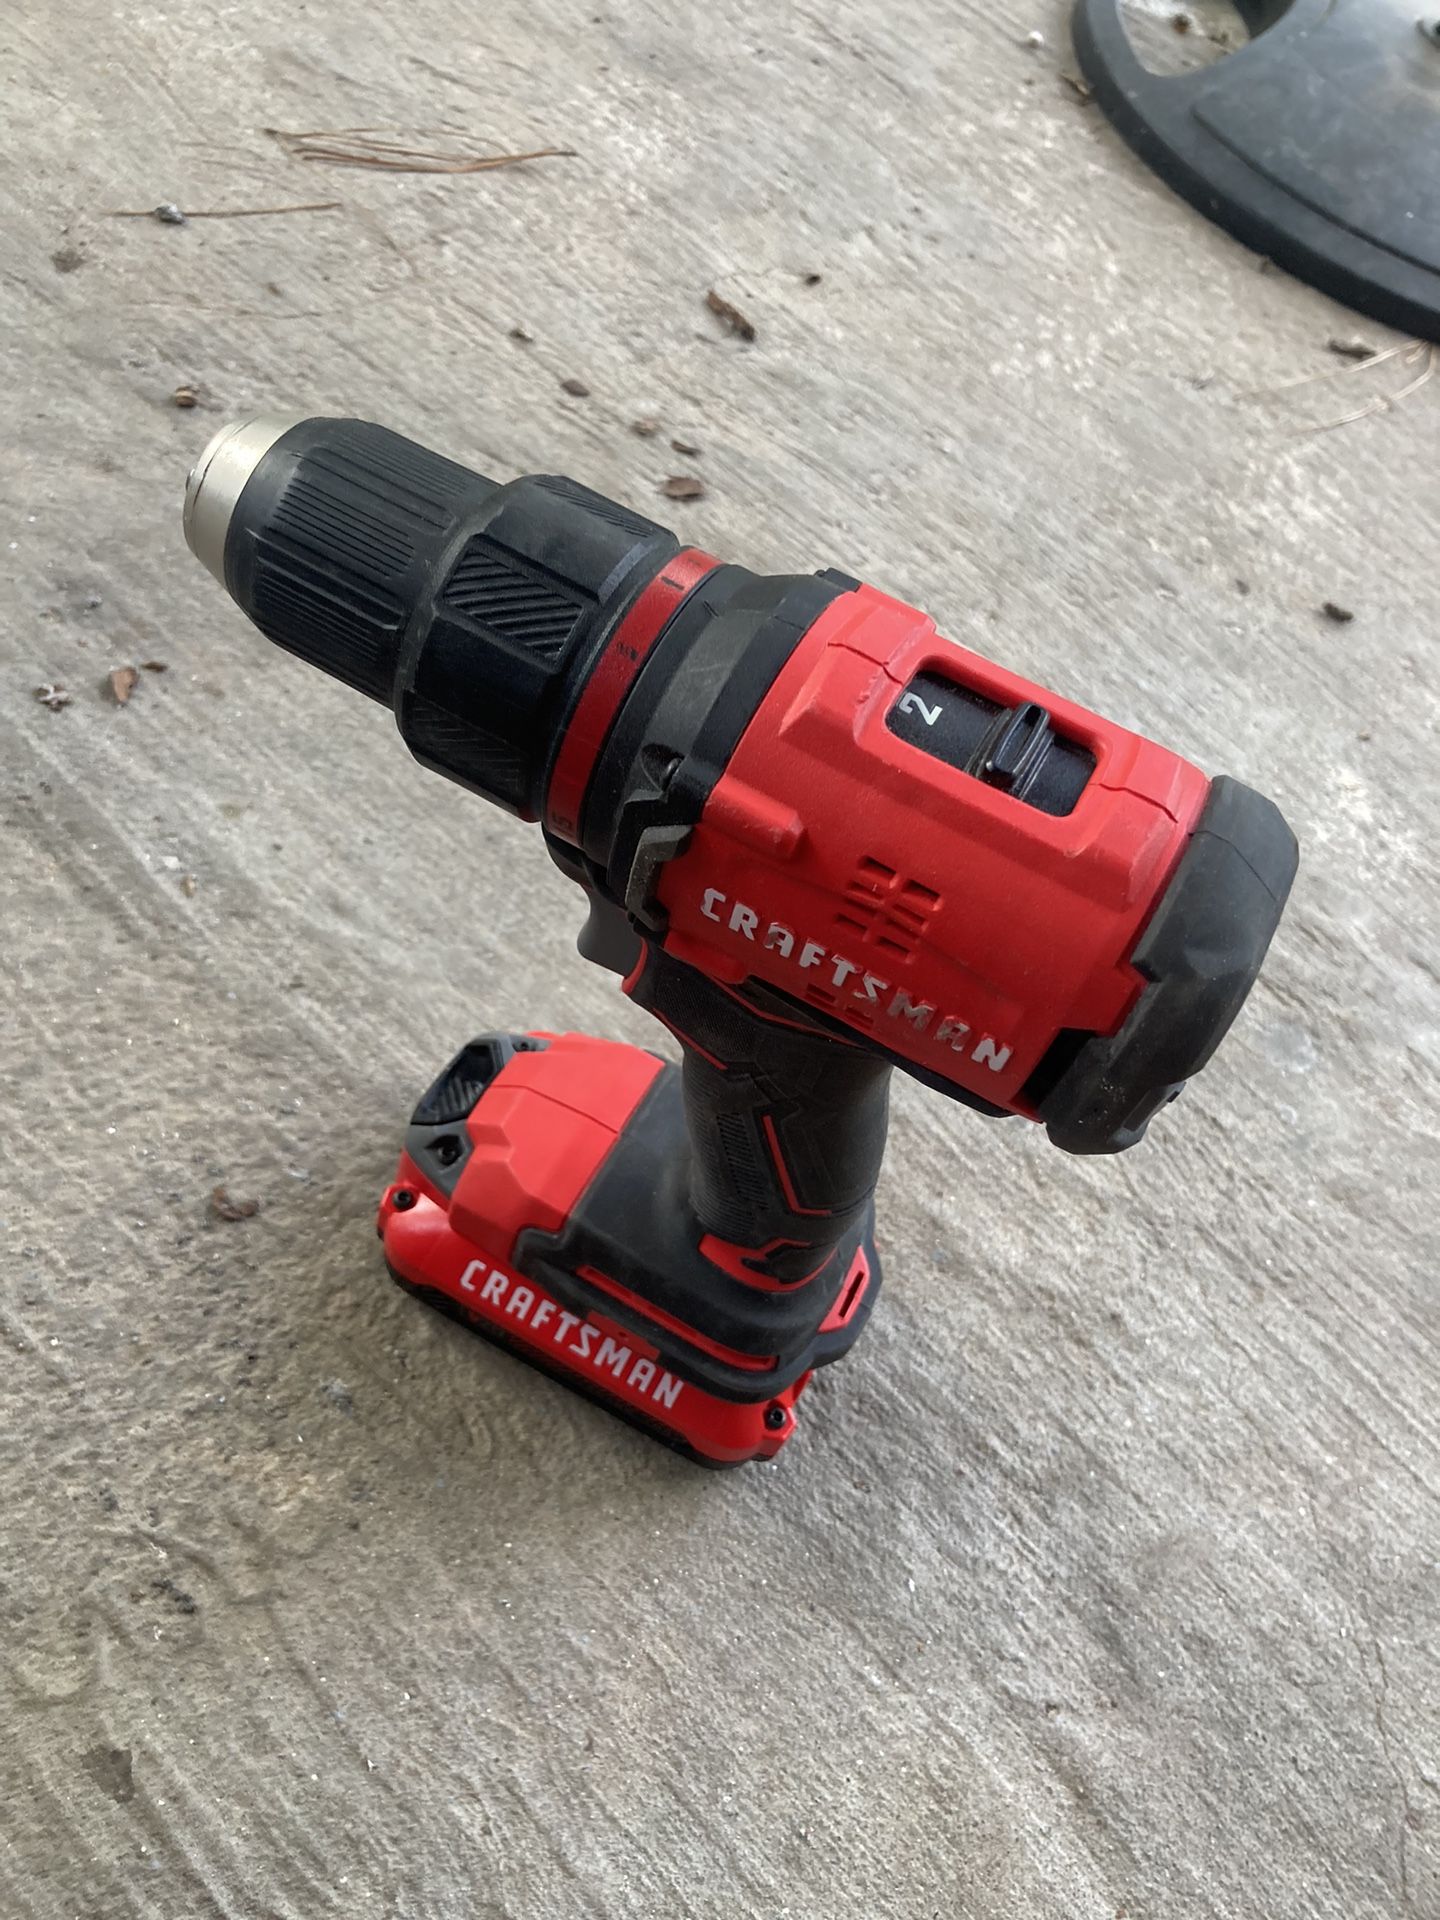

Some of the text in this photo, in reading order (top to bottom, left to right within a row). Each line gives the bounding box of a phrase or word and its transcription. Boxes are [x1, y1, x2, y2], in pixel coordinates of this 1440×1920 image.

[898, 691, 943, 726] 2
[700, 887, 1014, 1072] CRAFTSMAN
[460, 1259, 684, 1409] CRAFTSMAN
